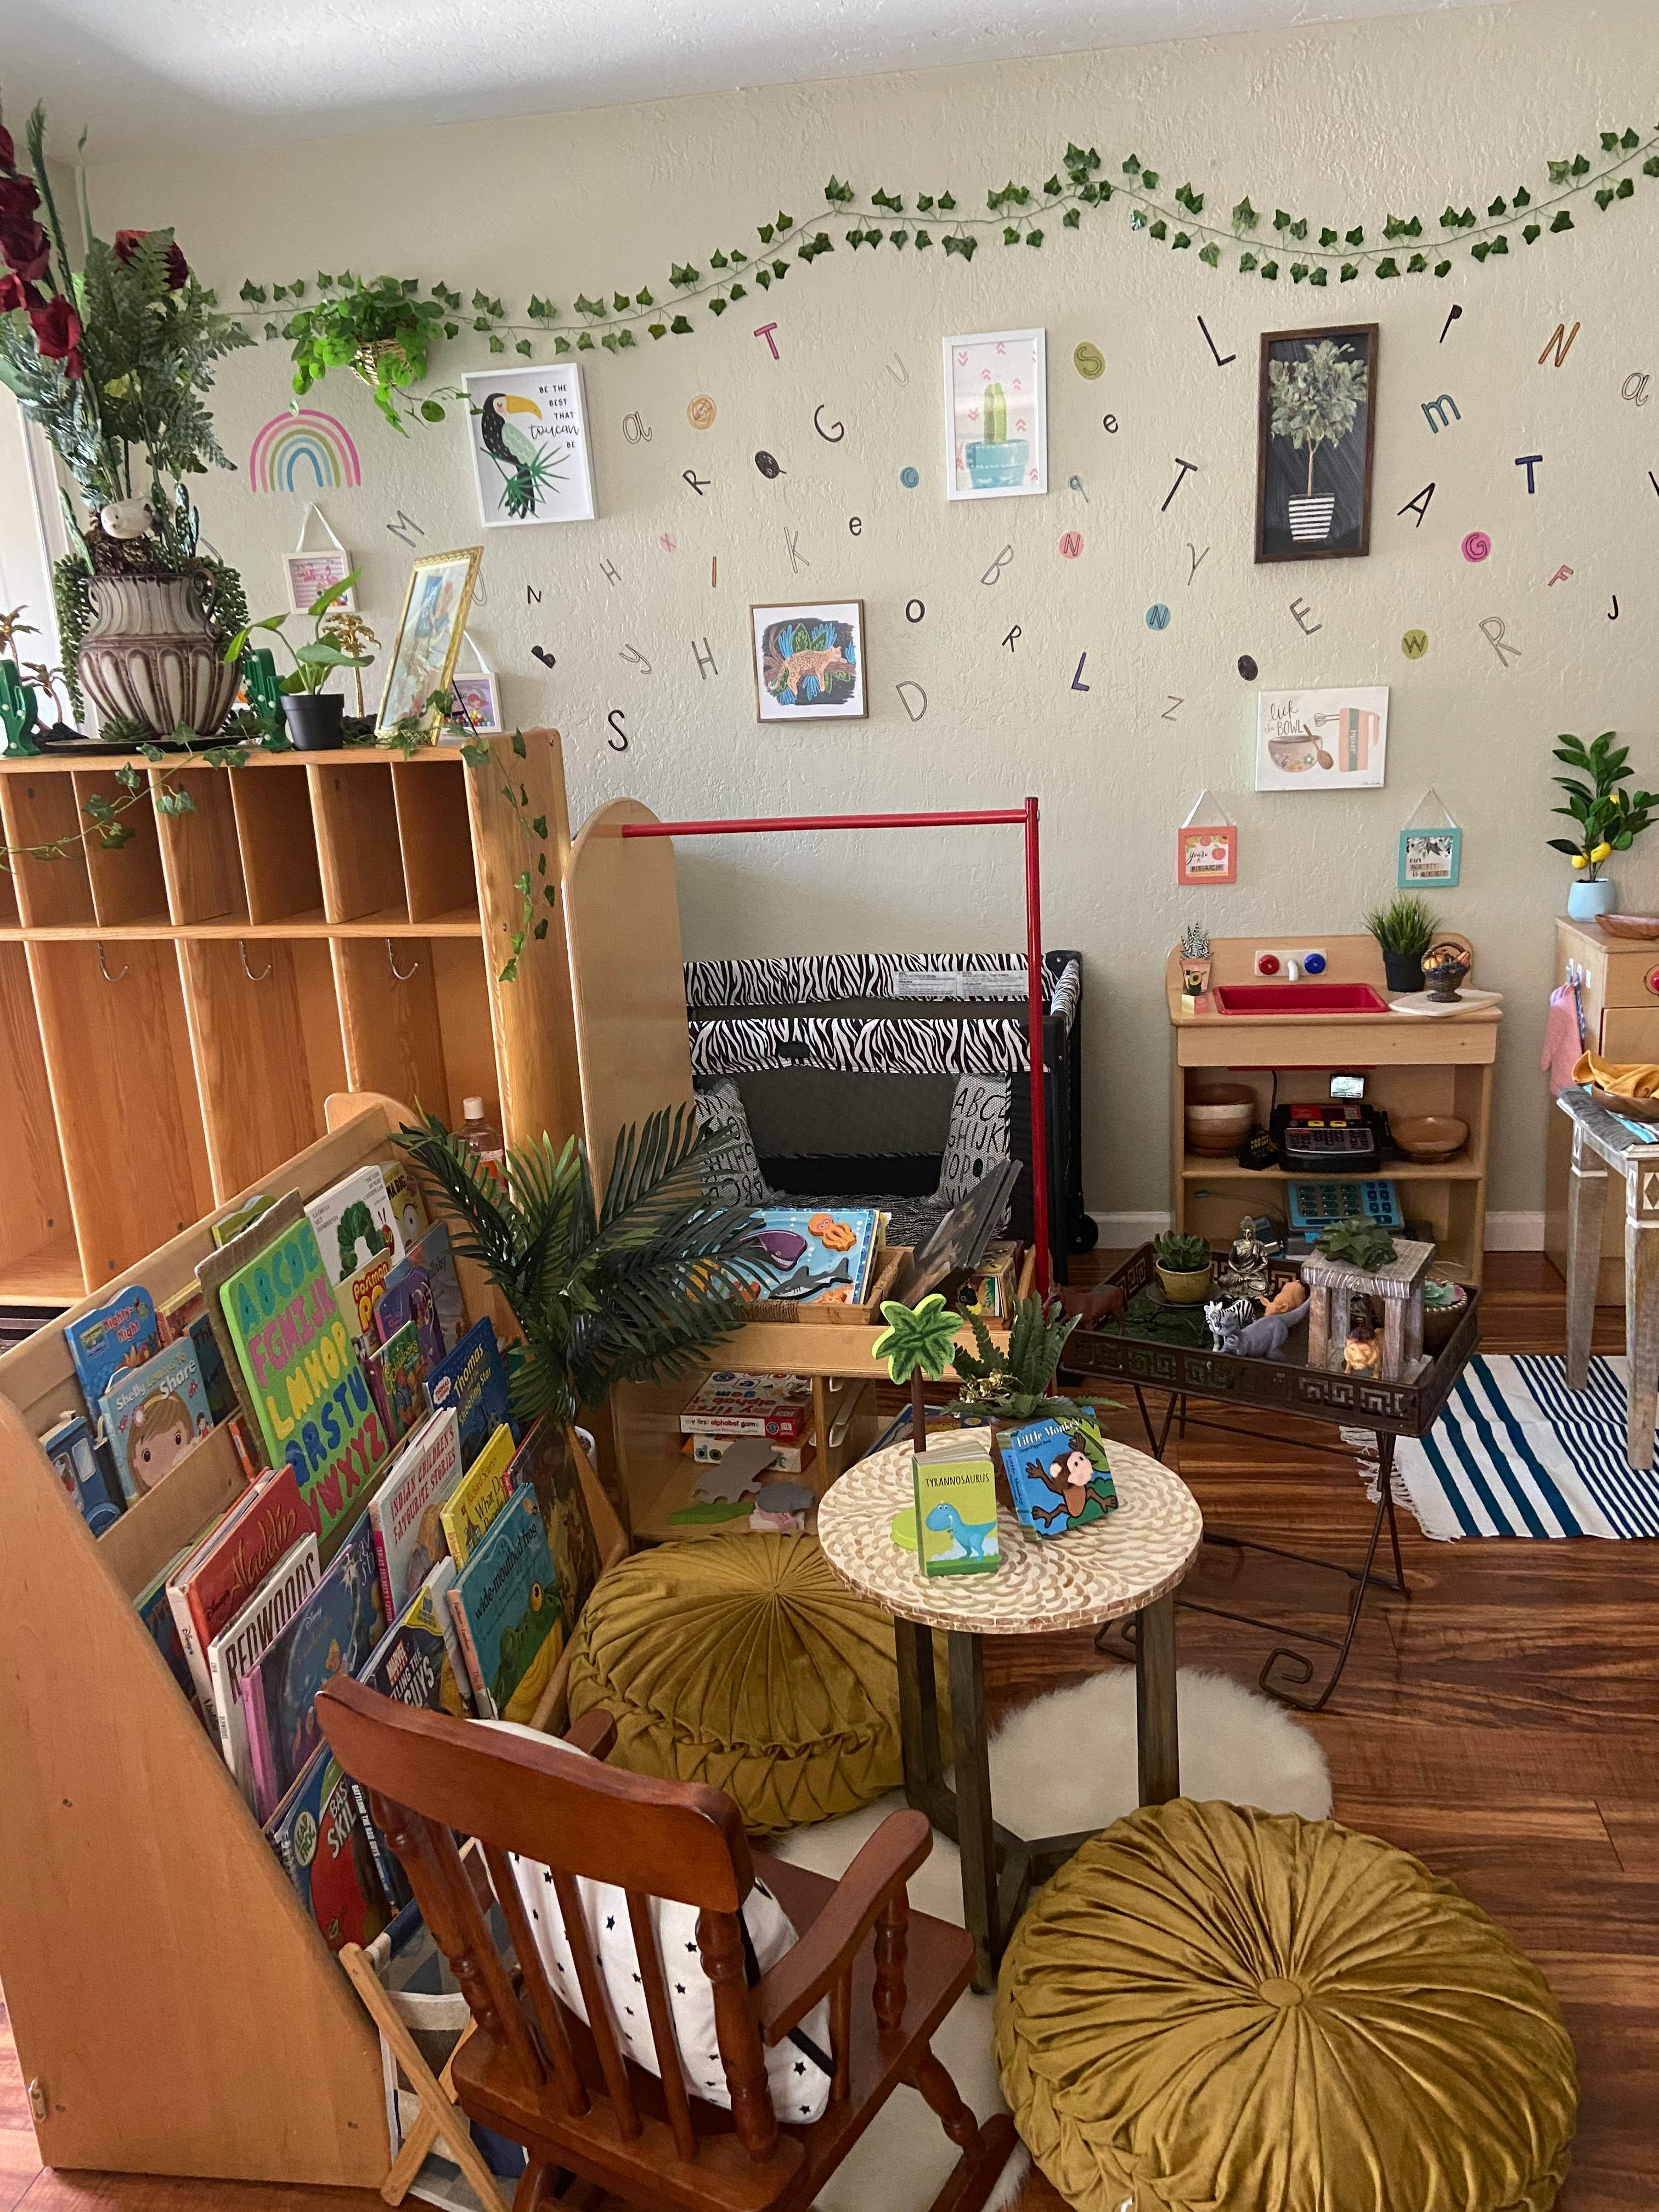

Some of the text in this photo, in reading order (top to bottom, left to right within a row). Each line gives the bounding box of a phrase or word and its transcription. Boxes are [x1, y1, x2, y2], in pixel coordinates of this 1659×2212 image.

[753, 321, 779, 360] T
[1197, 315, 1236, 366] L
[1439, 304, 1462, 343] P
[1076, 346, 1102, 376] S
[1538, 322, 1580, 367] N
[885, 352, 909, 386] U
[549, 398, 567, 407] BEST
[554, 411, 574, 420] THAT
[528, 424, 580, 440] toucan
[814, 404, 844, 443] G
[1103, 414, 1119, 433] e
[683, 470, 711, 495] R
[1161, 458, 1198, 512] T
[1515, 455, 1542, 494] T
[1397, 482, 1435, 528] A
[386, 510, 425, 548] M
[849, 517, 862, 536] e
[600, 558, 621, 585] H
[980, 545, 1014, 585] B
[1548, 565, 1573, 586] F
[527, 585, 541, 604] N
[1607, 595, 1618, 620] J
[1289, 597, 1322, 635] E
[1002, 625, 1022, 652] R
[1479, 616, 1521, 667] R
[691, 637, 718, 679] H
[1071, 652, 1090, 691] L
[896, 681, 927, 721] D
[608, 709, 628, 752] S
[1277, 719, 1304, 736] BOWL
[1191, 864, 1223, 872] PEACH
[394, 1175, 407, 1193] BIG
[238, 1224, 320, 1335] ABCDE
[160, 1359, 196, 1400] Share
[454, 1342, 484, 1399] Thomas
[116, 1384, 146, 1411] Shelly
[710, 1419, 740, 1427] alphabet
[1017, 1417, 1081, 1448] Little Monkey
[391, 1474, 416, 1521] INDIAN
[393, 1482, 430, 1545] FAVOURITE
[430, 1447, 456, 1491] STORIES
[925, 1473, 990, 1488] TYRANNOSAURUS
[475, 1491, 494, 1519] What
[226, 1504, 297, 1607] Aladdin
[475, 1533, 523, 1620] wide-mouthed
[522, 1523, 538, 1547] frog
[410, 1646, 422, 1673] THE
[204, 1698, 218, 1731] Aladdin
[361, 1815, 371, 1826] THE
